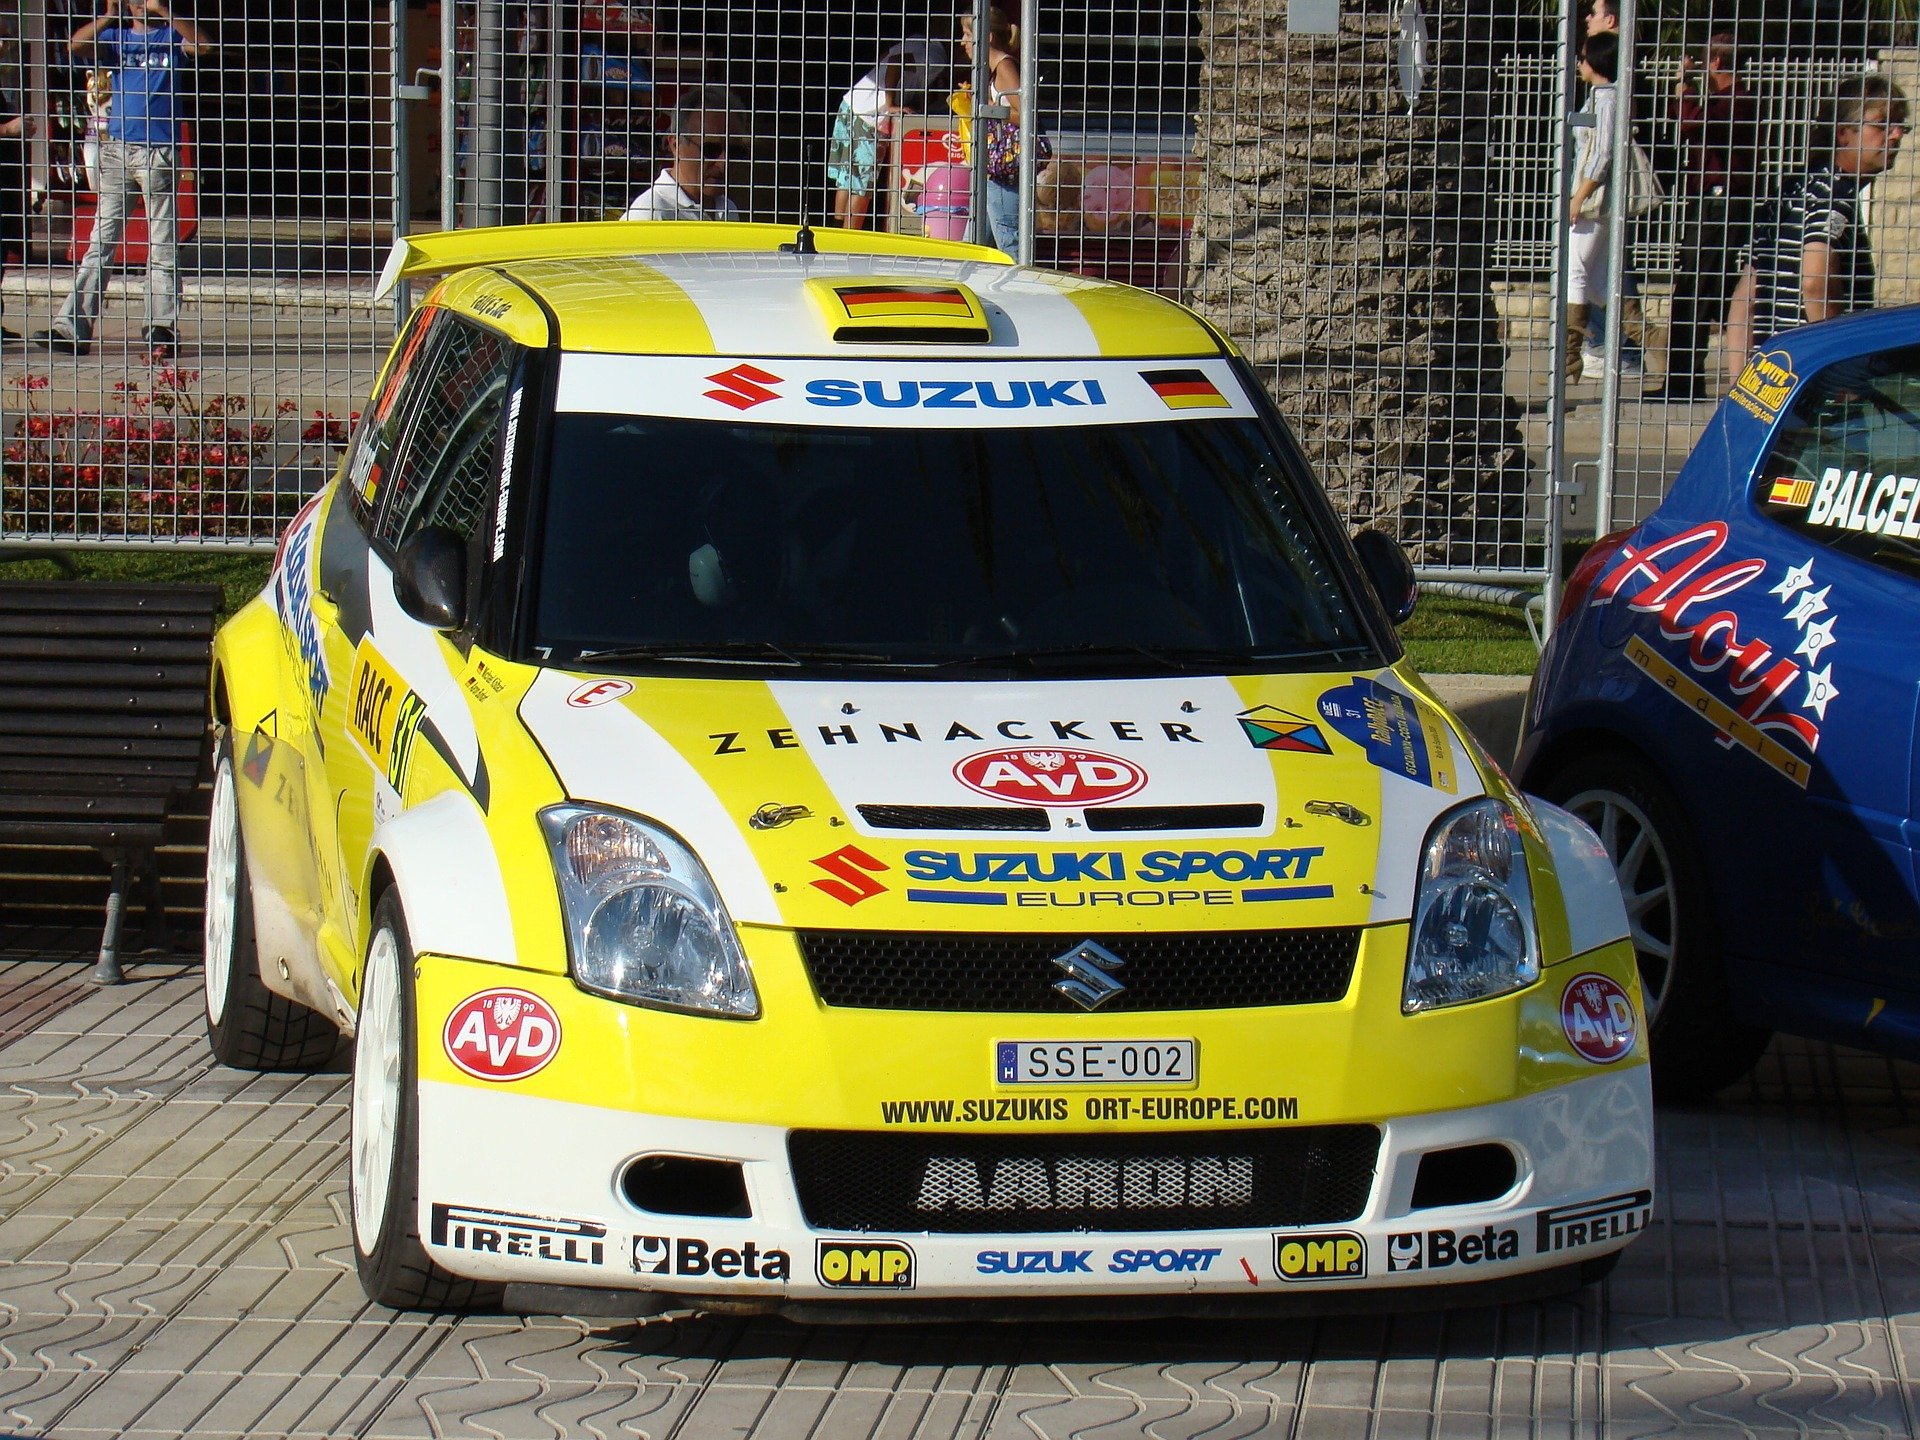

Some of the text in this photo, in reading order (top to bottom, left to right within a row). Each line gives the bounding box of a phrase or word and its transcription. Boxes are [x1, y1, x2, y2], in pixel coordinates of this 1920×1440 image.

[805, 379, 1106, 409] SUZUKI
[355, 660, 392, 754] RACC
[1633, 648, 1798, 776] madrid
[709, 719, 1203, 755] ZEHNACKER
[905, 846, 1325, 882] SUZUKI SPORT
[1017, 889, 1234, 906] EUROPE
[483, 1000, 535, 1013] 18 99
[1004, 1067, 1013, 1079] H
[1028, 1046, 1182, 1078] SSE-002
[882, 1097, 1298, 1123] WWW.SUZUKIS ORT-EUROPE.COM
[915, 1156, 1253, 1211] AARON
[431, 1203, 606, 1265] PIRELLI
[1536, 1190, 1651, 1253] PIRELLI
[677, 1239, 790, 1279] Beta
[977, 1248, 1222, 1273] SUZUK SPORT
[1280, 1240, 1361, 1274] OMP
[1428, 1226, 1519, 1267] Beta
[822, 1249, 910, 1281] OMP
